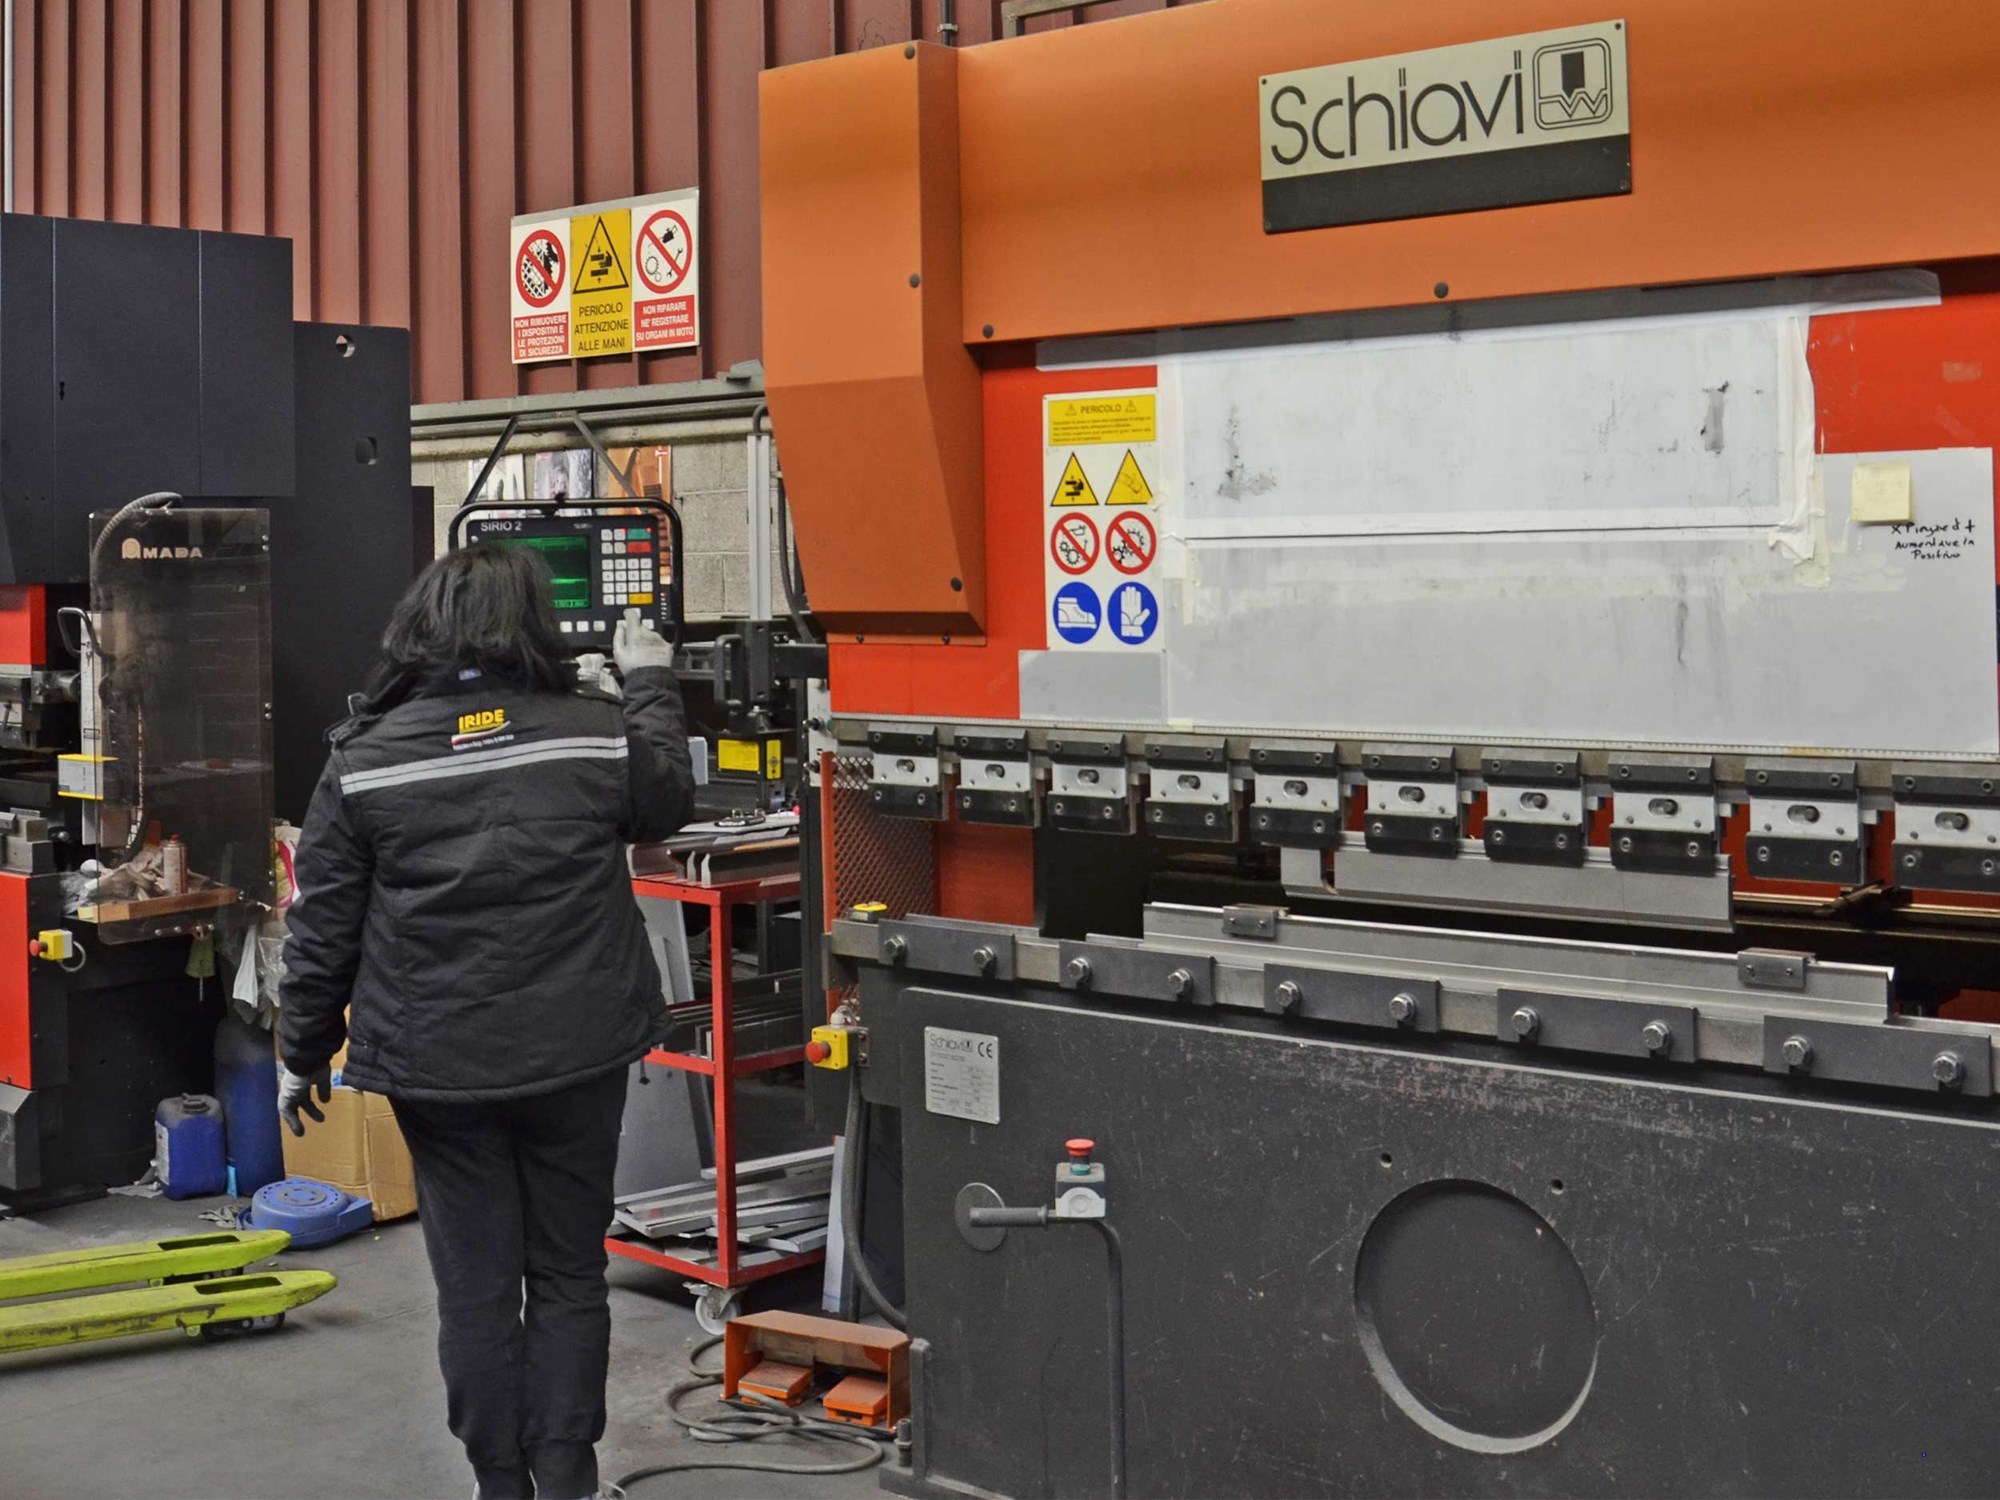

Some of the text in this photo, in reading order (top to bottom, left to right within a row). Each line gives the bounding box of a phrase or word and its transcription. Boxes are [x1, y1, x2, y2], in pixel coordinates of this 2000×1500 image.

[1270, 49, 1524, 166] Schiavi
[578, 301, 623, 318] PERICOLO
[642, 301, 687, 315] NON RIPARARE
[514, 314, 567, 329] NON RIMUOVERE
[574, 318, 629, 335] ATTENZIONE
[651, 313, 689, 327] REGISTRARE
[521, 326, 559, 338] DISPOSITIVI
[635, 326, 694, 342] SU ORGANI IN MOTO
[517, 335, 565, 348] LE PROTEZIONI
[577, 337, 625, 352] ALLE MANI
[518, 345, 564, 358] DI SICUREZZA
[1080, 403, 1122, 414] PERICOLO
[480, 520, 522, 532] SIRIO 2
[121, 537, 203, 559] AMADA
[458, 708, 505, 731] IRIDE
